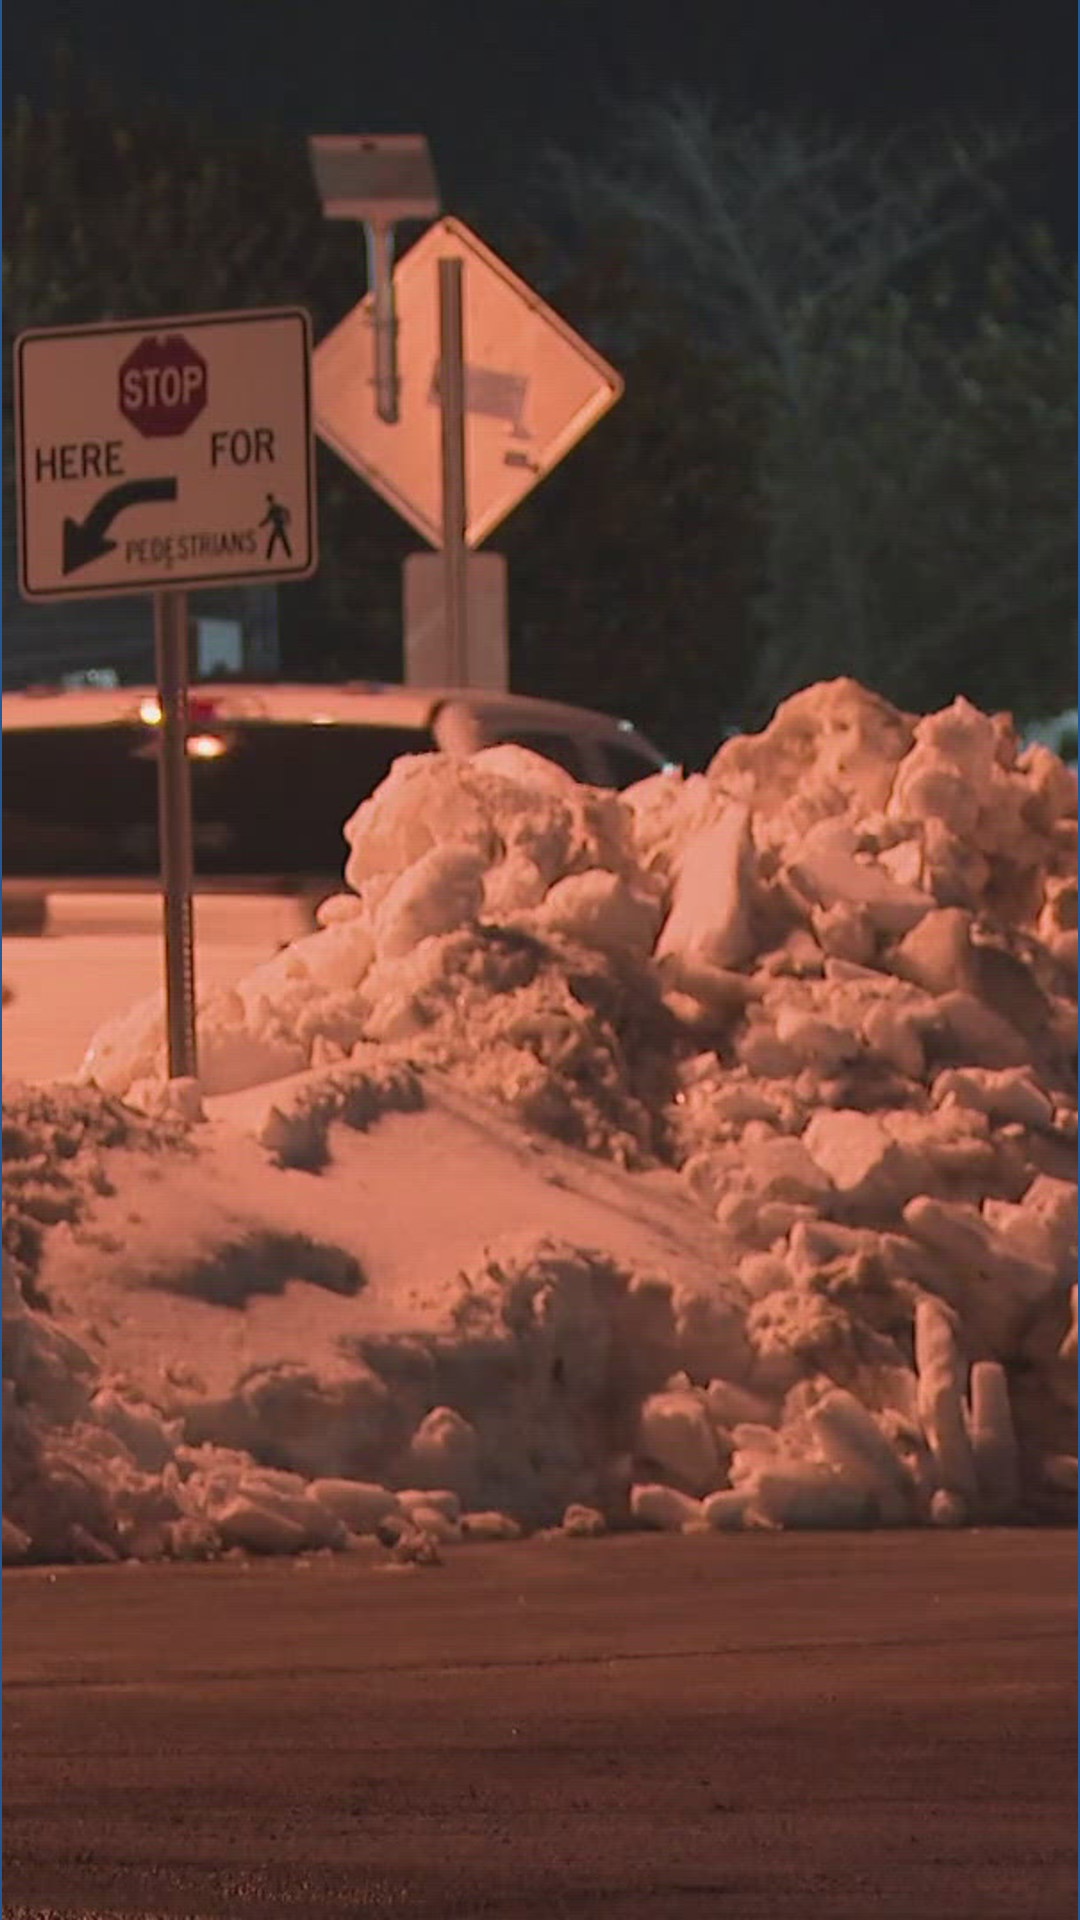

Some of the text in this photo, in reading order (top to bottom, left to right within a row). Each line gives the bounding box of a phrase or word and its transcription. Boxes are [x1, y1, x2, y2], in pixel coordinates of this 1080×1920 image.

[123, 365, 203, 408] STOP
[35, 427, 275, 482] HERE FOR
[125, 529, 258, 564] PEDESTRIANS
